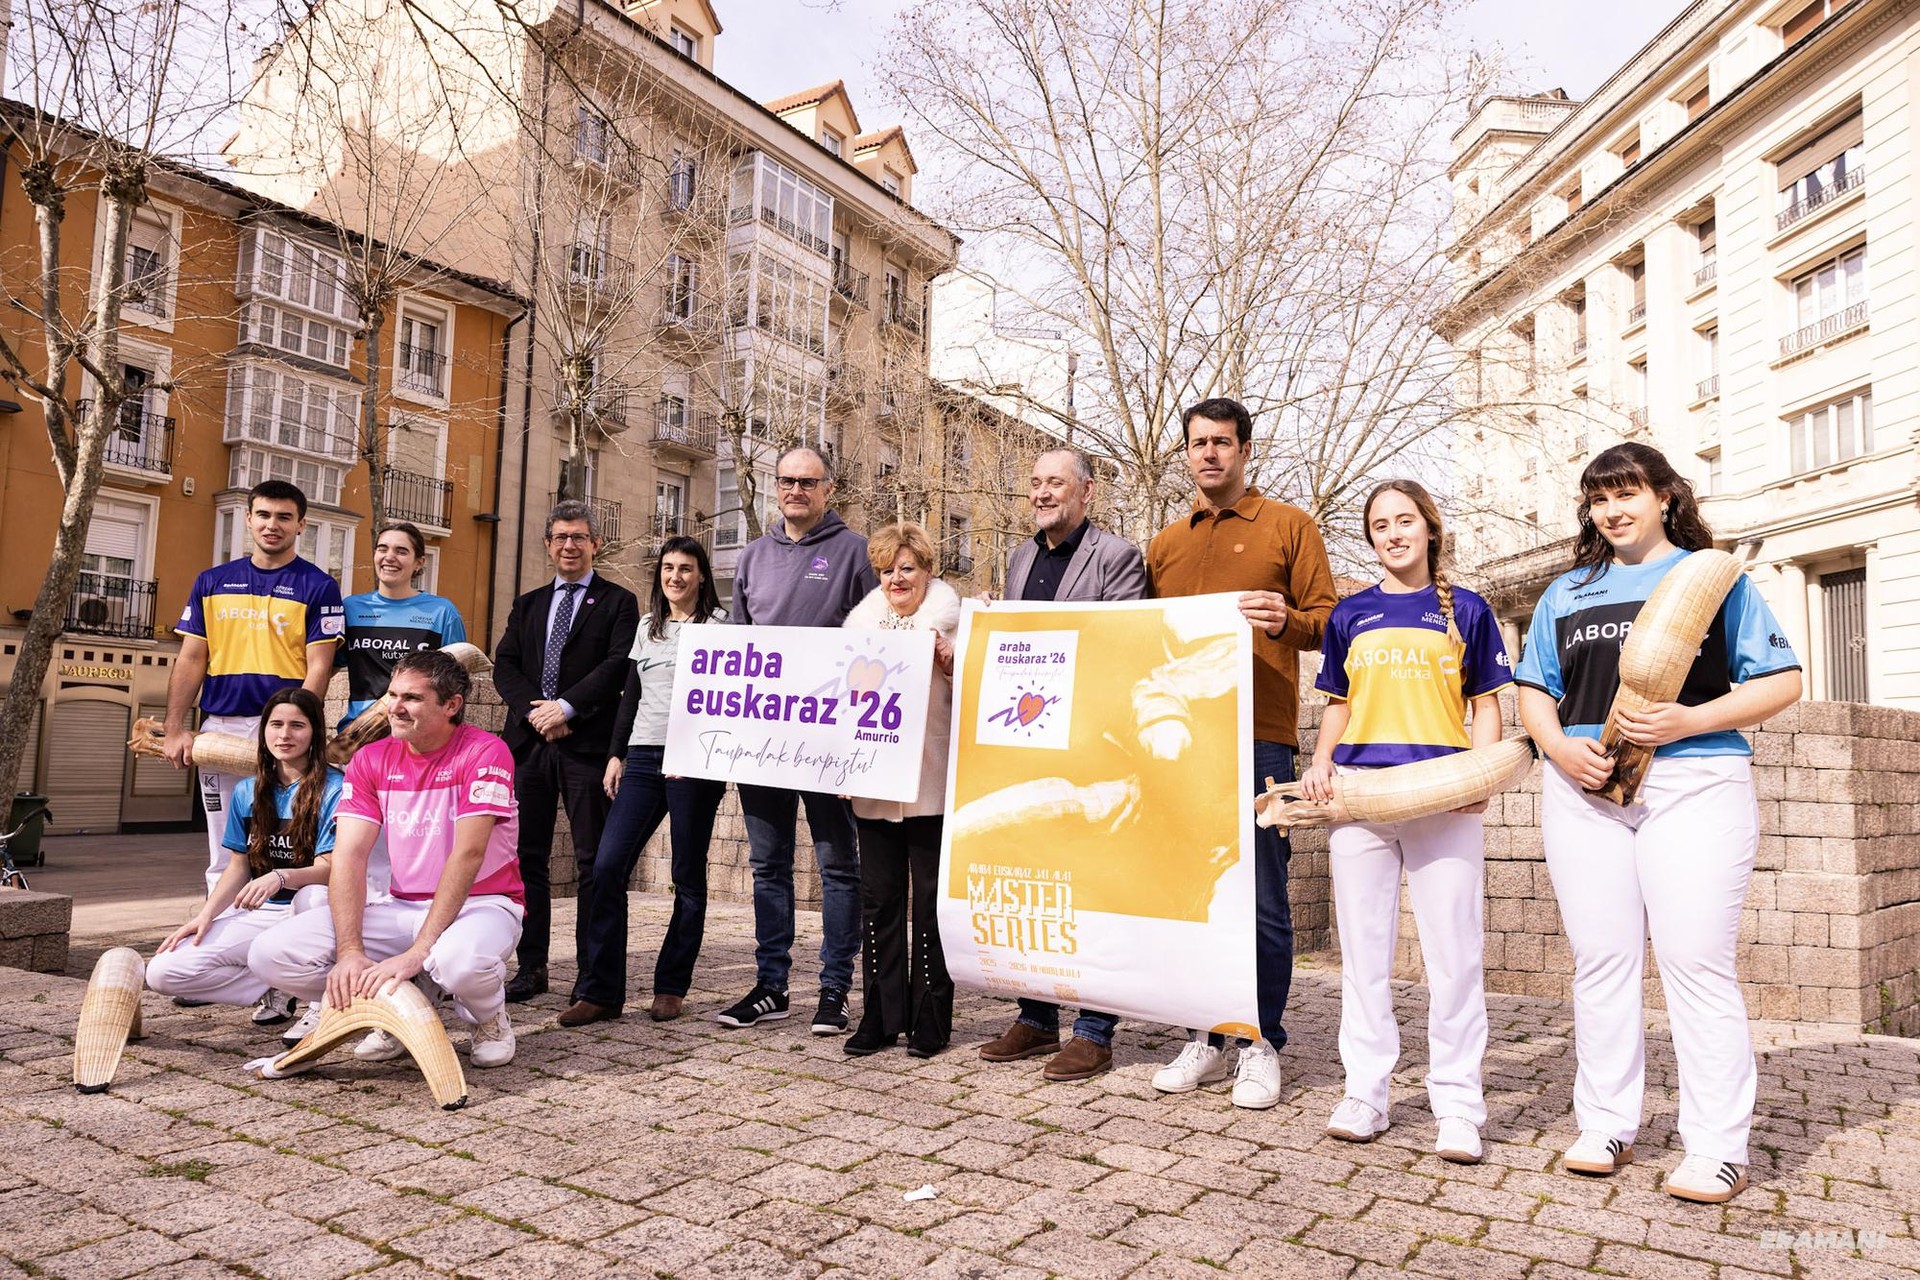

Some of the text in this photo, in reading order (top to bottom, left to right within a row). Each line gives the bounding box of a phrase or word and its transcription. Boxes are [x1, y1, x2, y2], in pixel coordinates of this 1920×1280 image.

[999, 641, 1031, 652] araba
[1565, 621, 1632, 650] LABOR
[691, 642, 783, 679] araba
[998, 652, 1066, 664] euskaraz '26
[1391, 667, 1431, 680] kutxa
[687, 683, 902, 731] euskaraz '26
[854, 729, 900, 744] Amurrio
[698, 730, 878, 787] Taupadak berpiztu!
[967, 873, 1074, 922] MASTER
[972, 912, 1077, 955] SERIES
